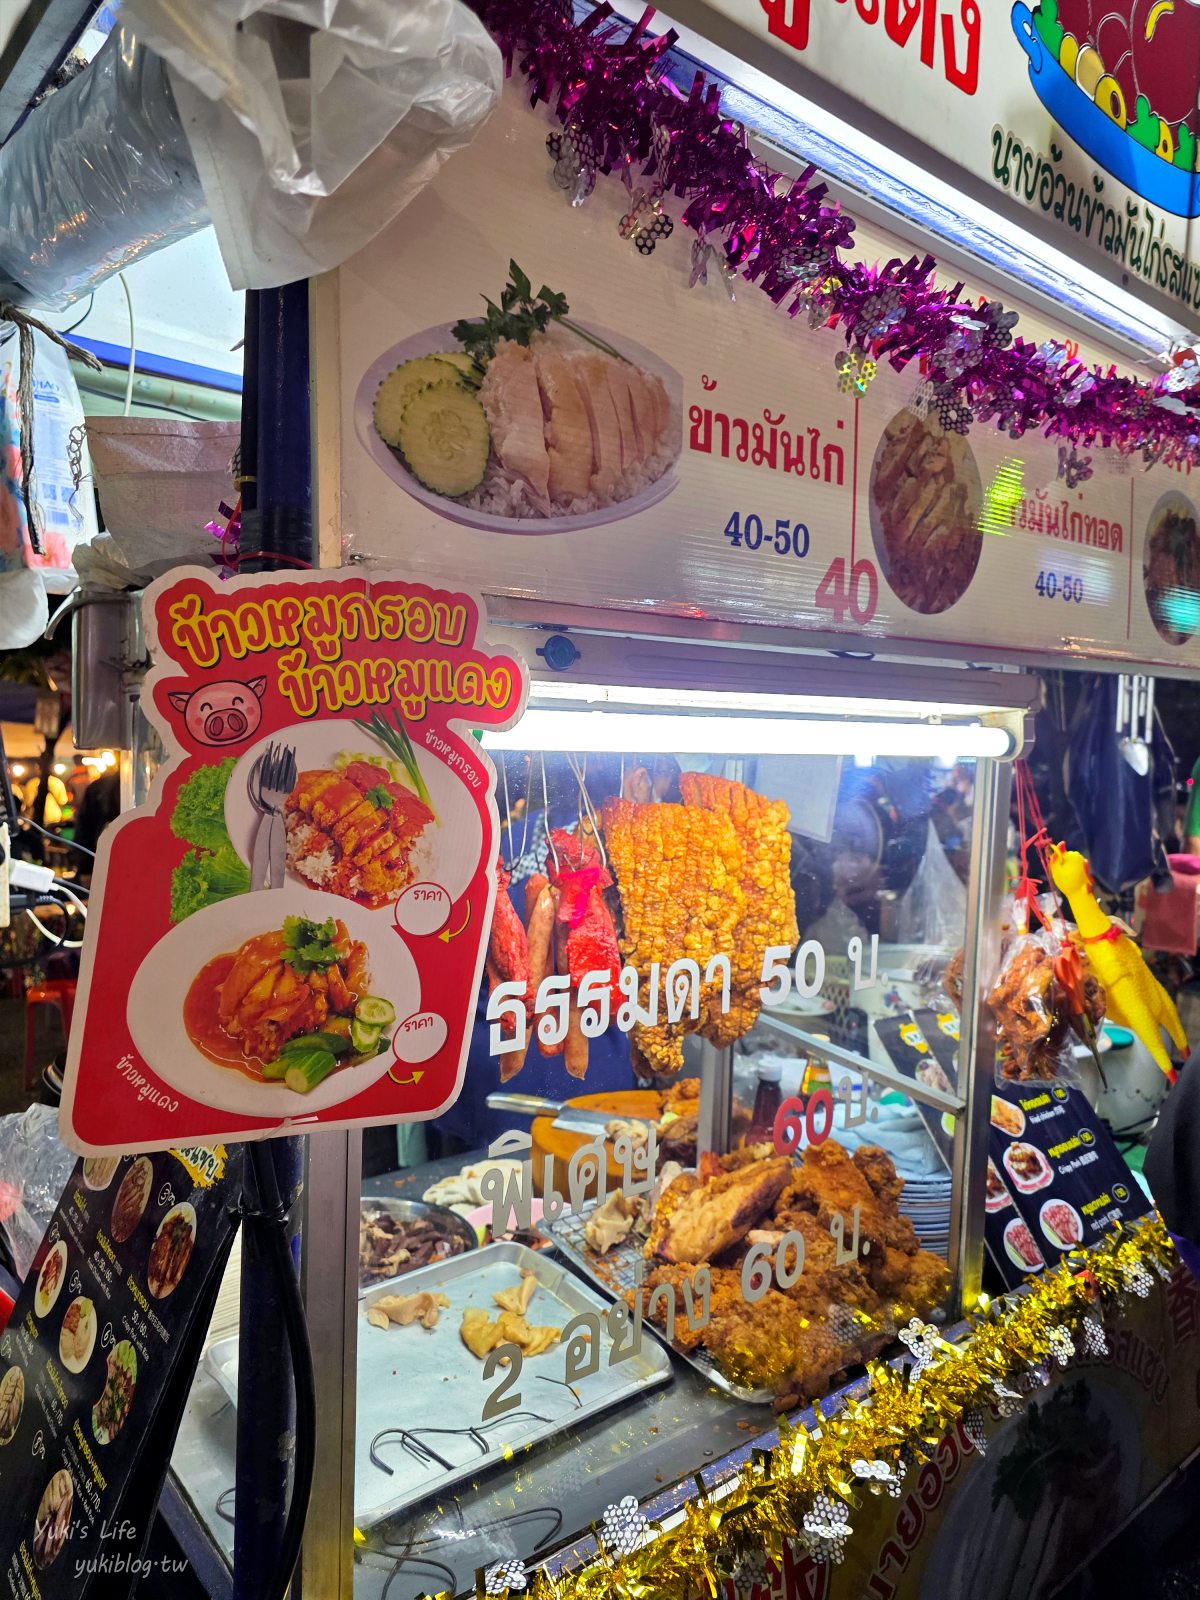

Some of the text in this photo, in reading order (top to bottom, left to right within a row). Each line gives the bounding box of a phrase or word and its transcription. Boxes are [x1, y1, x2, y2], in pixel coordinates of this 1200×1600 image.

[688, 374, 845, 486] ข้าวมันไก่
[723, 511, 810, 559] 40-50
[814, 556, 879, 626] 40
[1035, 571, 1084, 604] 40-50
[169, 592, 468, 668] ข้าวหมูกรอบ
[278, 647, 512, 721] ข้าวหมูแดง
[424, 728, 482, 790] ข้าวหมูกรอบ
[413, 888, 443, 902] ราคา
[403, 1014, 435, 1033] ราคา
[485, 933, 889, 1056] ธรรมดา 50 บ.
[116, 1053, 180, 1113] ข้าวหมูแดง
[480, 1072, 880, 1239] พิเศษ 60 บ.
[481, 1207, 871, 1422] 2 อย่าง 60 บ.
